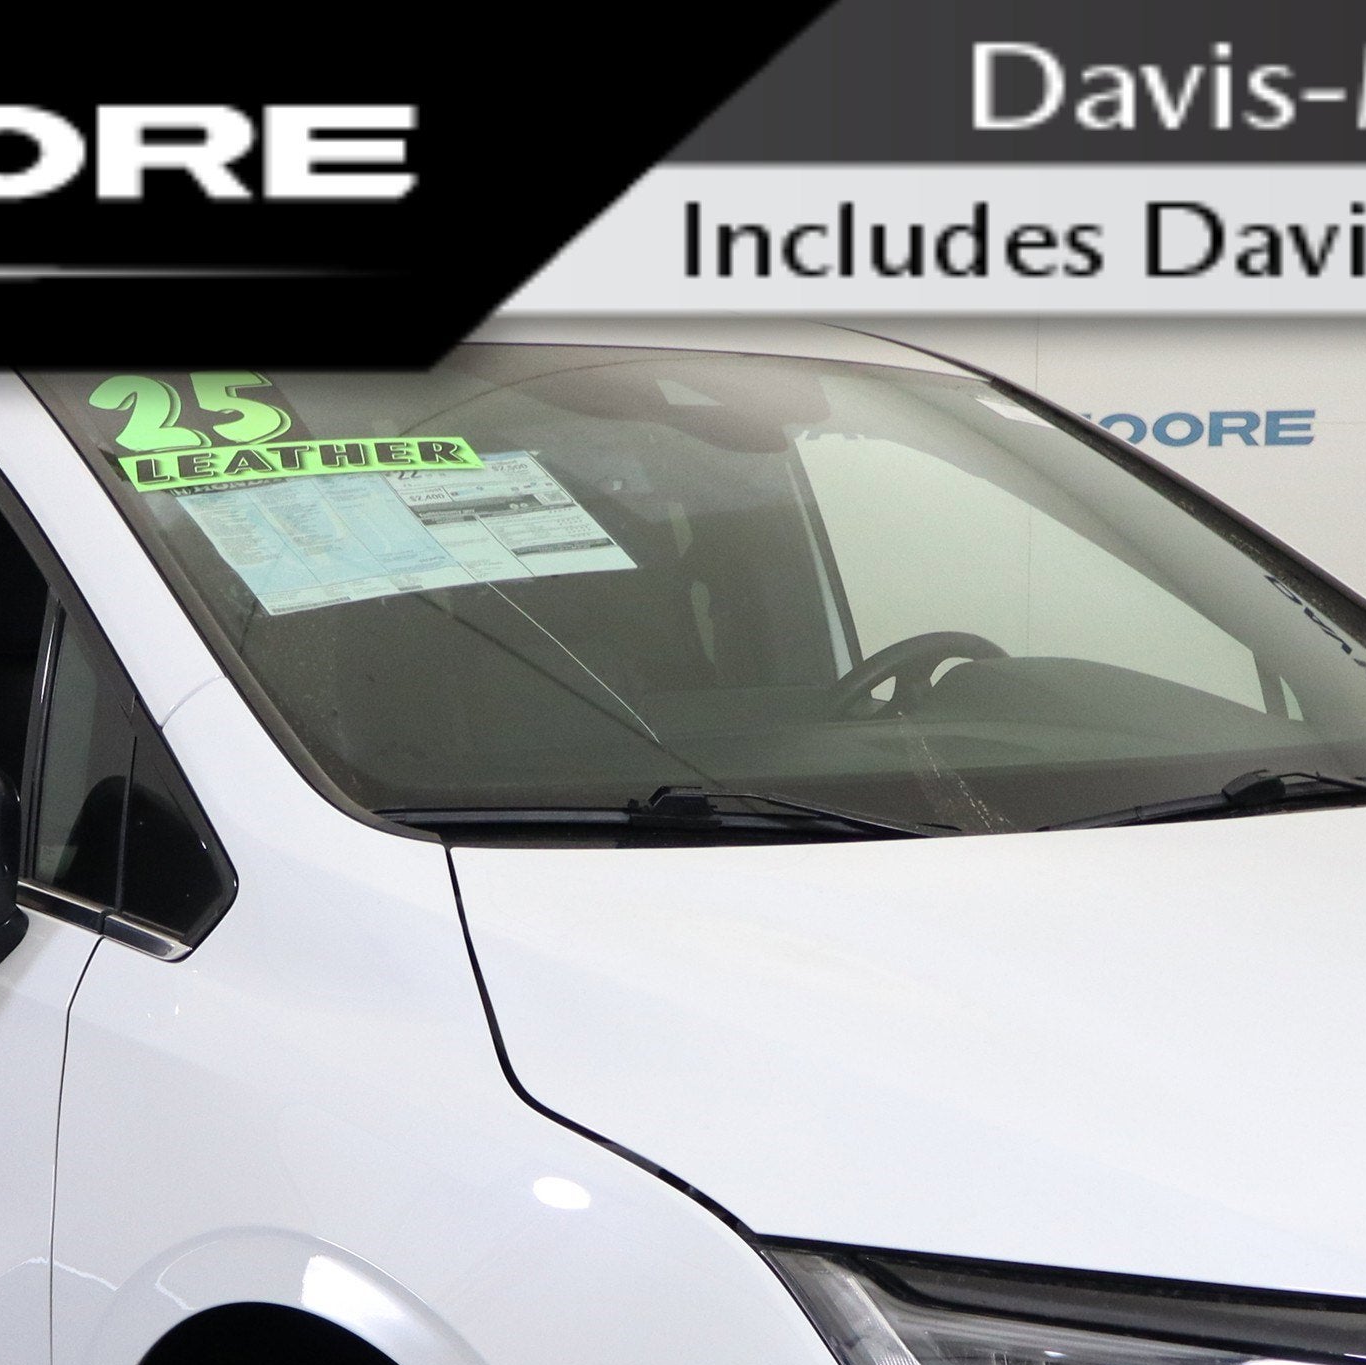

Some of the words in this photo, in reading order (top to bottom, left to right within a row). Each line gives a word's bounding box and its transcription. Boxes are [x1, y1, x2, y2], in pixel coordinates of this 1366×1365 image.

[88, 369, 292, 453] 25
[1082, 409, 1316, 447] OORE
[135, 440, 467, 486] LEATHER
